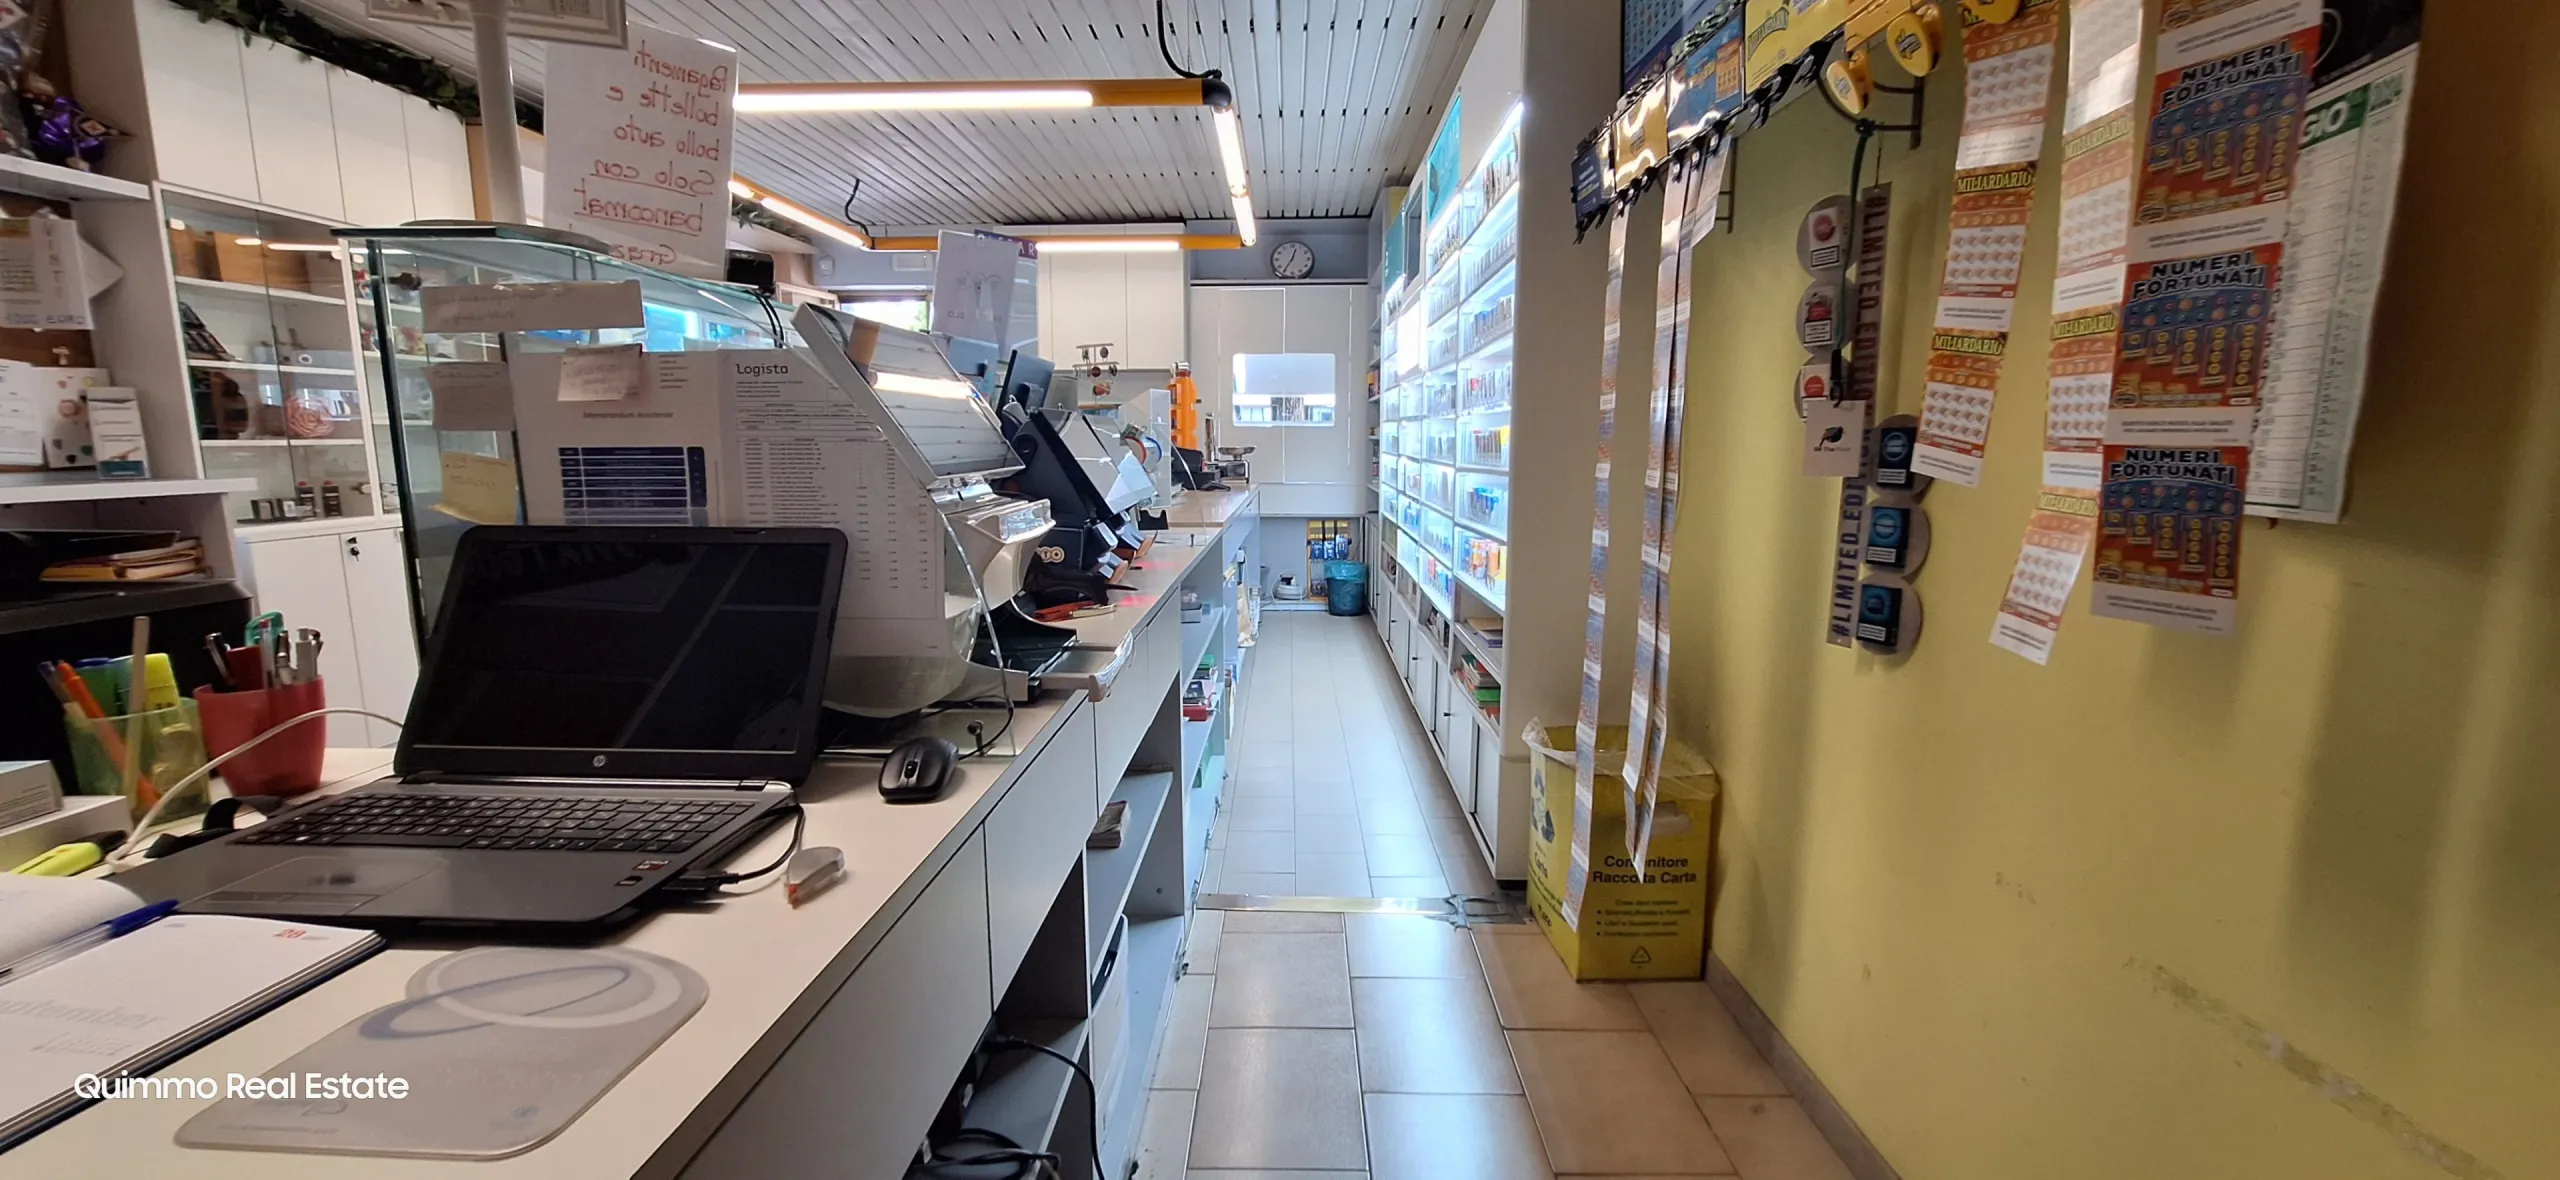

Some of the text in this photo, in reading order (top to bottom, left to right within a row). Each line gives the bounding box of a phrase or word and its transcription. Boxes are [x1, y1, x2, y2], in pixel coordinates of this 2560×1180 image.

[2180, 39, 2290, 85] NUMERI
[2160, 52, 2302, 110] FORTUNATI
[2302, 100, 2349, 144] GIO
[1957, 171, 2032, 193] MILIARDARIO
[2152, 252, 2254, 278] NUMERI
[2132, 266, 2267, 299] FORTUNATI
[2053, 313, 2117, 338] MILIARDARIO
[1933, 335, 2004, 356] MILIARDARIO
[2126, 449, 2220, 464] NUMERI
[2110, 463, 2236, 485] FORTUNATI
[1603, 855, 1689, 868] Connitore
[1592, 871, 1697, 884] Raccota Carta
